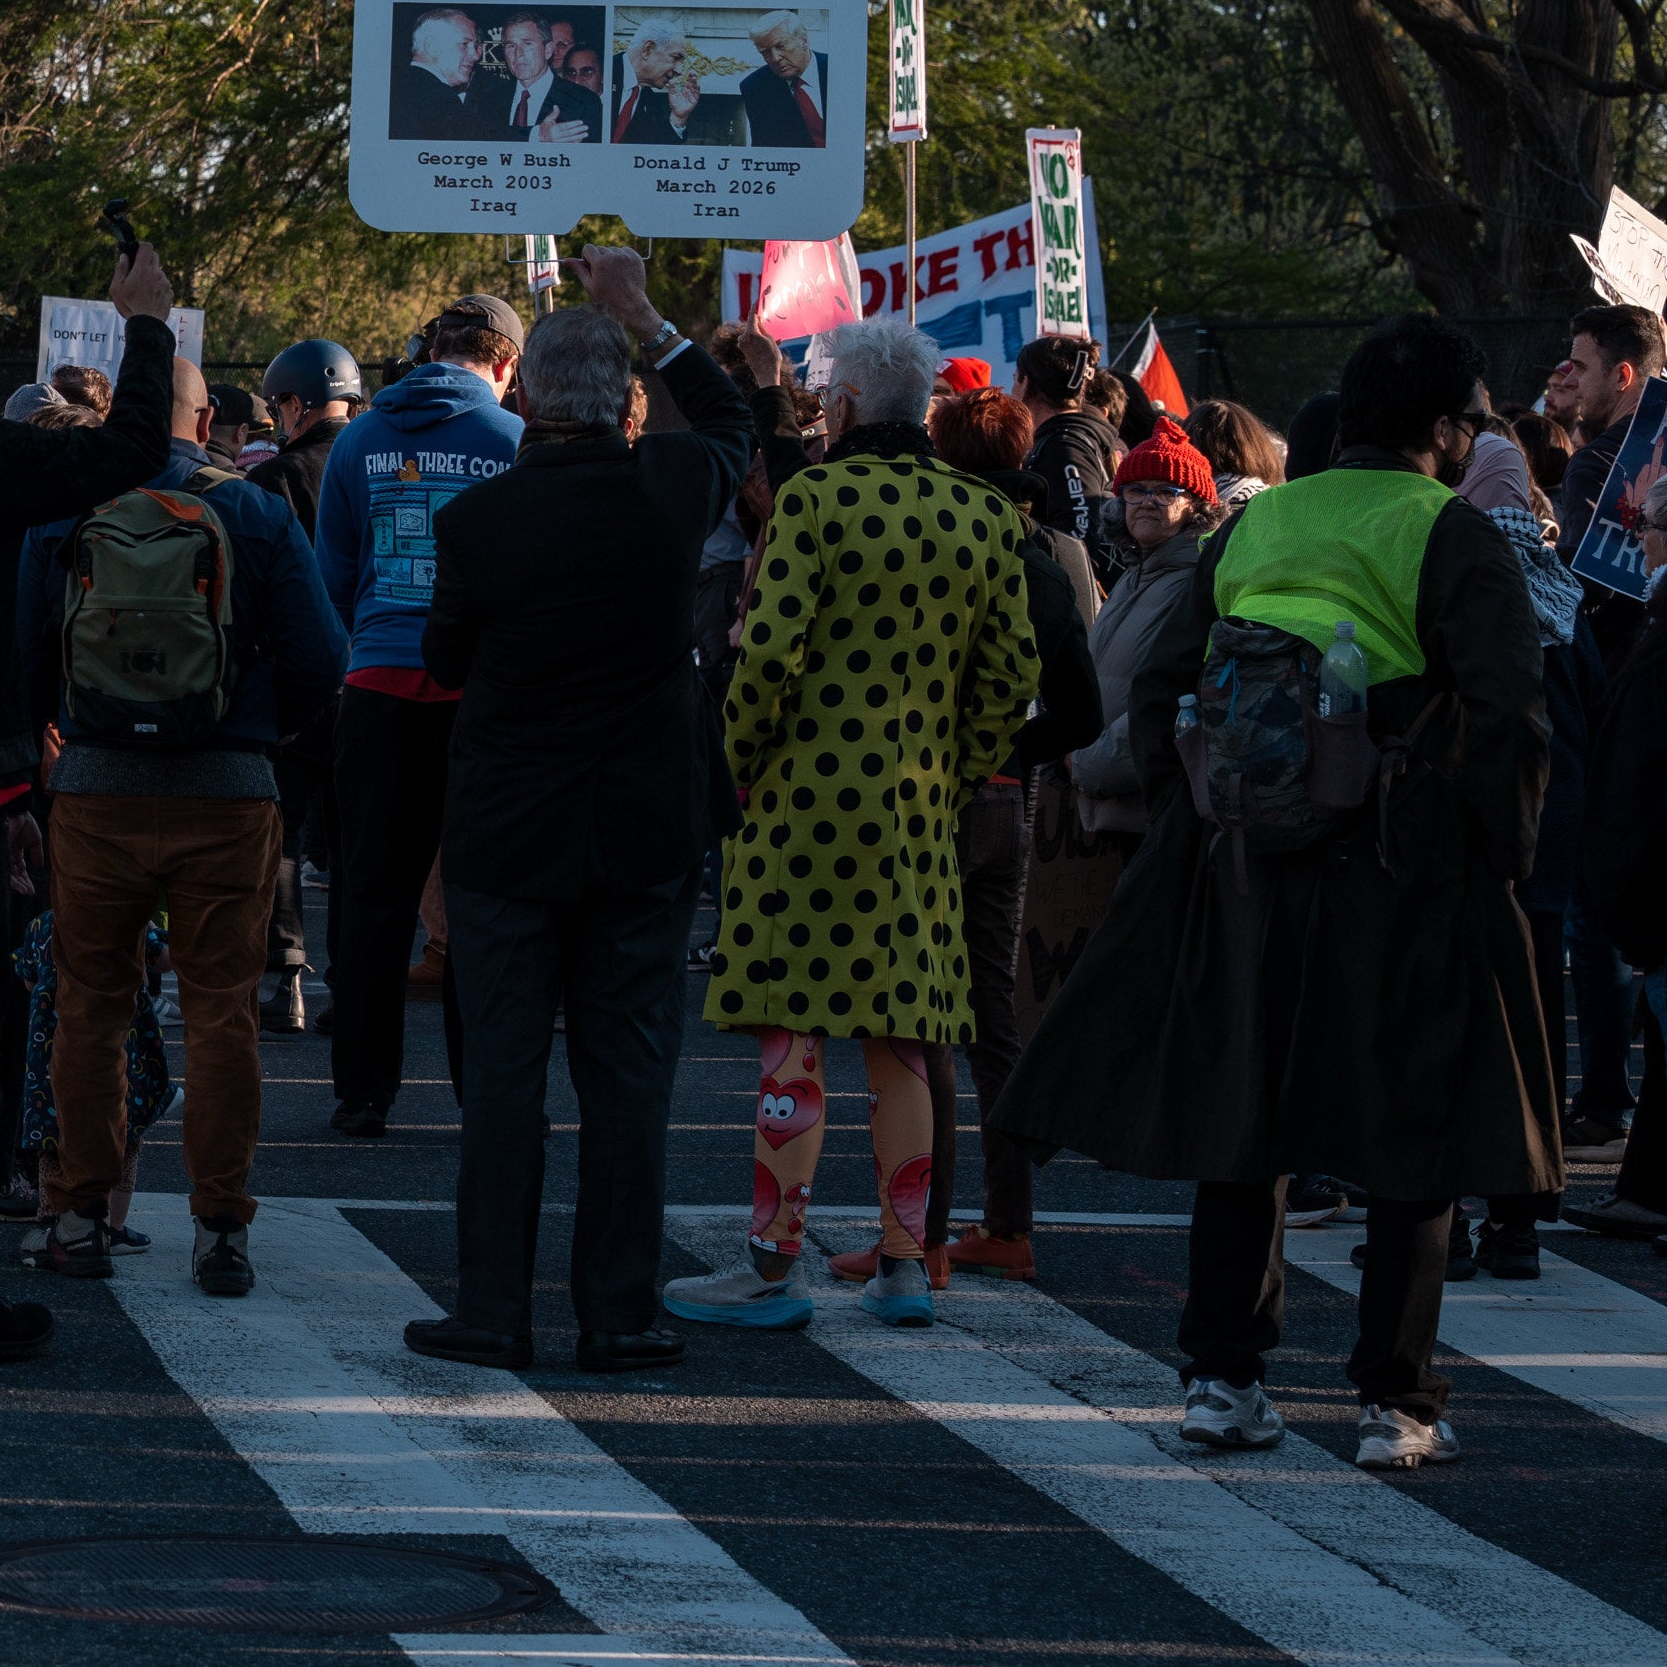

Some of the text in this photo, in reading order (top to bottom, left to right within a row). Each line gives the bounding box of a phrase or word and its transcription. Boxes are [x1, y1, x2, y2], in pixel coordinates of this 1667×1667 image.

[418, 152, 571, 169] George W Bush
[633, 156, 801, 176] Donald J Trump
[434, 175, 552, 189] March 2003
[656, 179, 776, 195] March 2026
[470, 199, 517, 216] Iraq
[693, 204, 740, 217] Iran
[54, 330, 88, 341] DON'T
[90, 332, 107, 343] LET
[365, 452, 406, 476] FINAL
[417, 452, 467, 475] THREE
